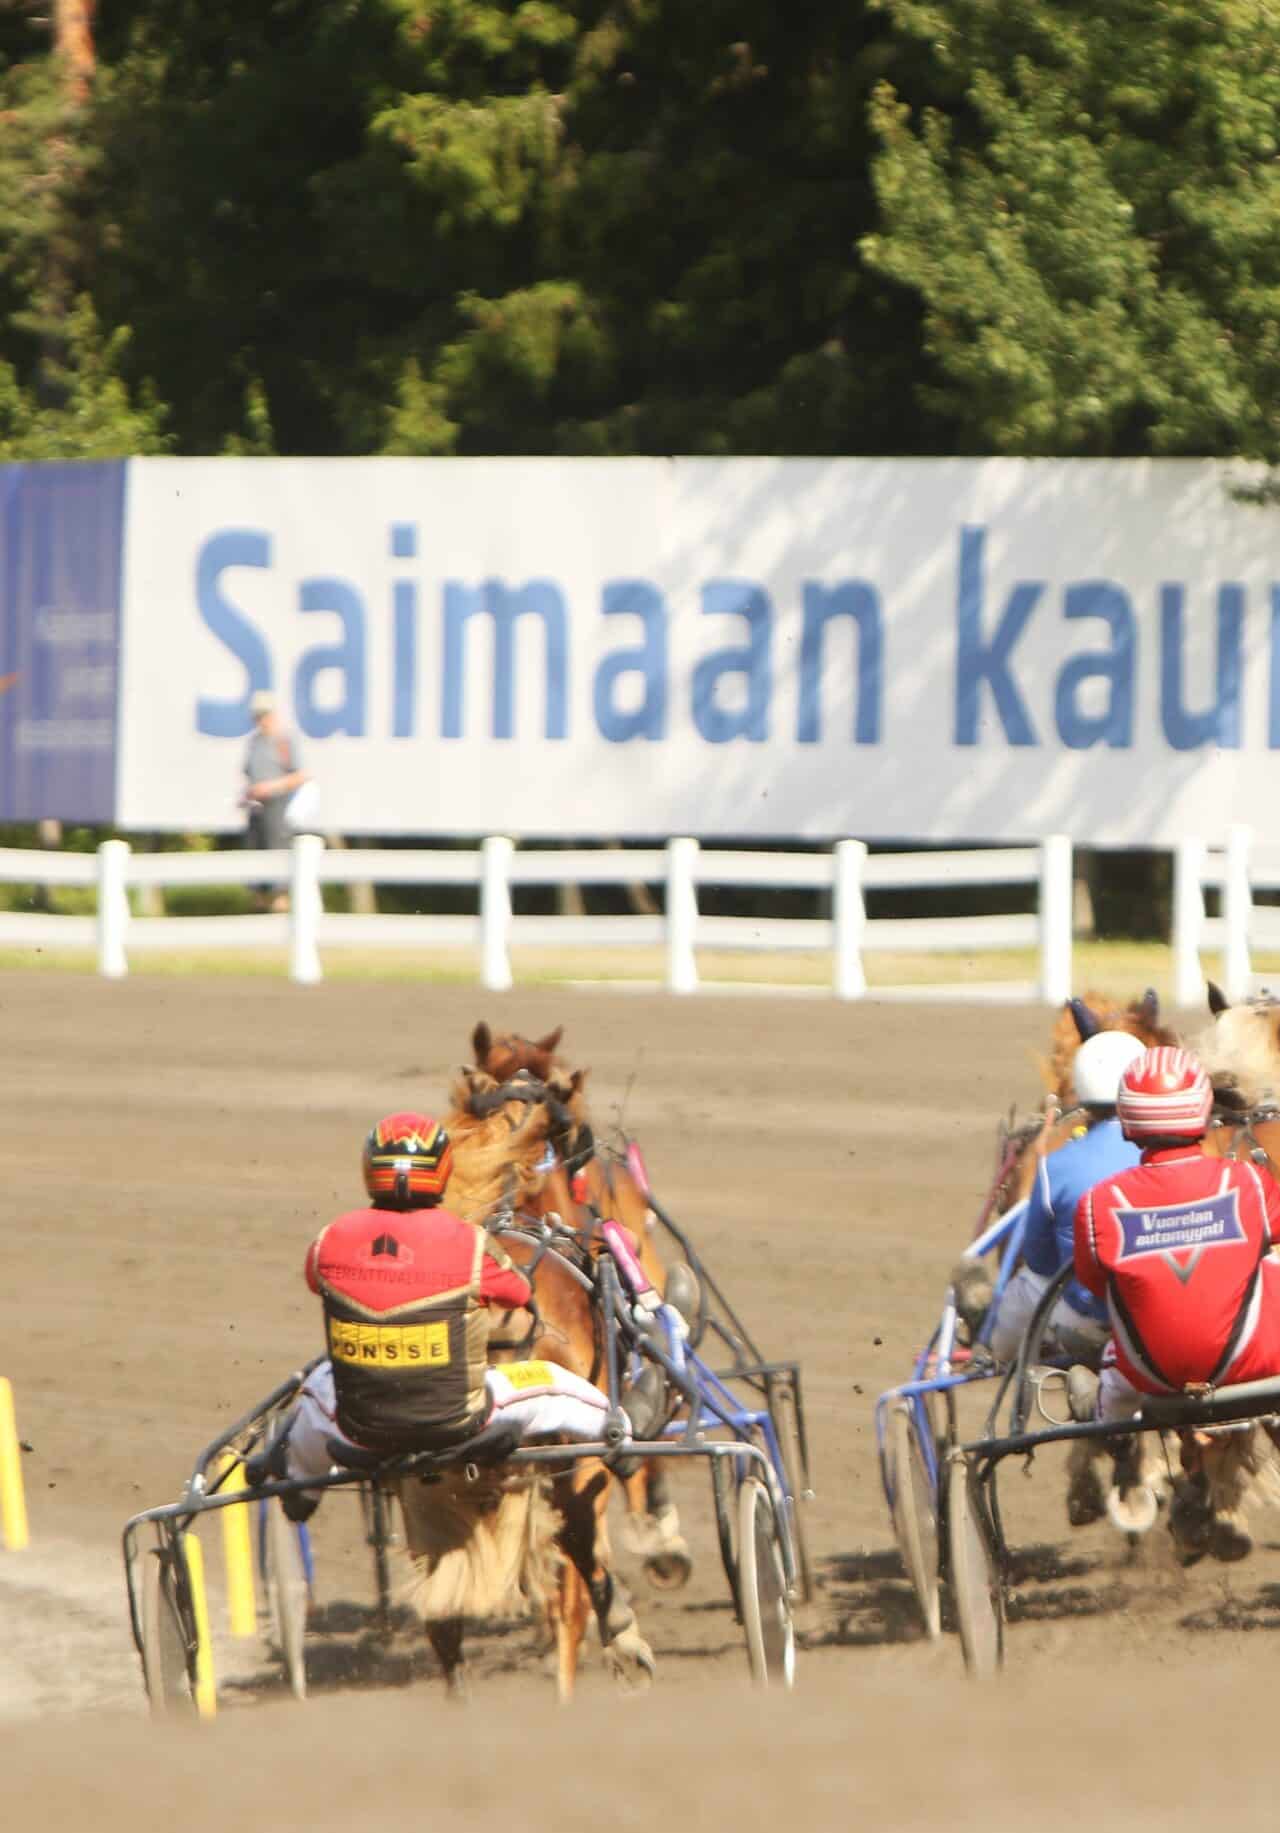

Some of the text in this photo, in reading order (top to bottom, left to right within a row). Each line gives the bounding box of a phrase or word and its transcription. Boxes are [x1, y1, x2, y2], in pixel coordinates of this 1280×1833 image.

[195, 522, 884, 745] Saimaan
[1135, 1219, 1225, 1247] automyynti
[1142, 1210, 1214, 1231] Vuorelan
